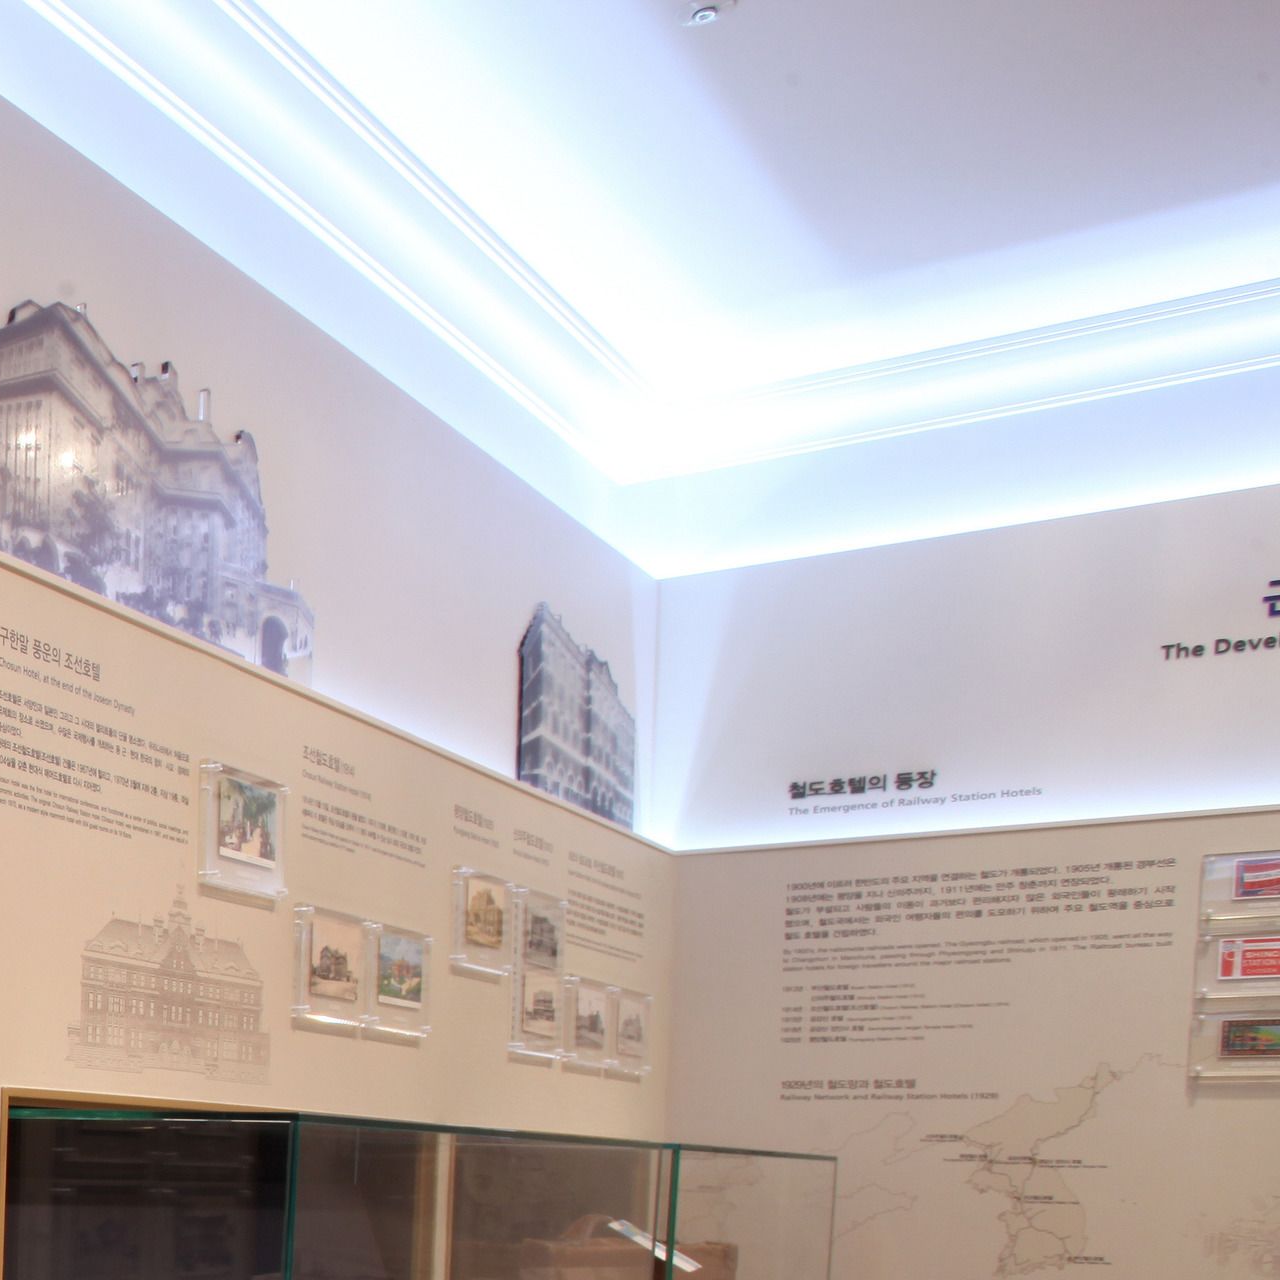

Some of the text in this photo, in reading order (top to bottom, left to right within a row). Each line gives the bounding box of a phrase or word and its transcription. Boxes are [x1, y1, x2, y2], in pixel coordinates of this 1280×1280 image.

[1160, 633, 1280, 661] The Deve
[64, 653, 100, 681] 조선호텔
[788, 769, 938, 800] 철도호텔의 등장
[789, 787, 1042, 815] The Emergence of Railway Station Hotels
